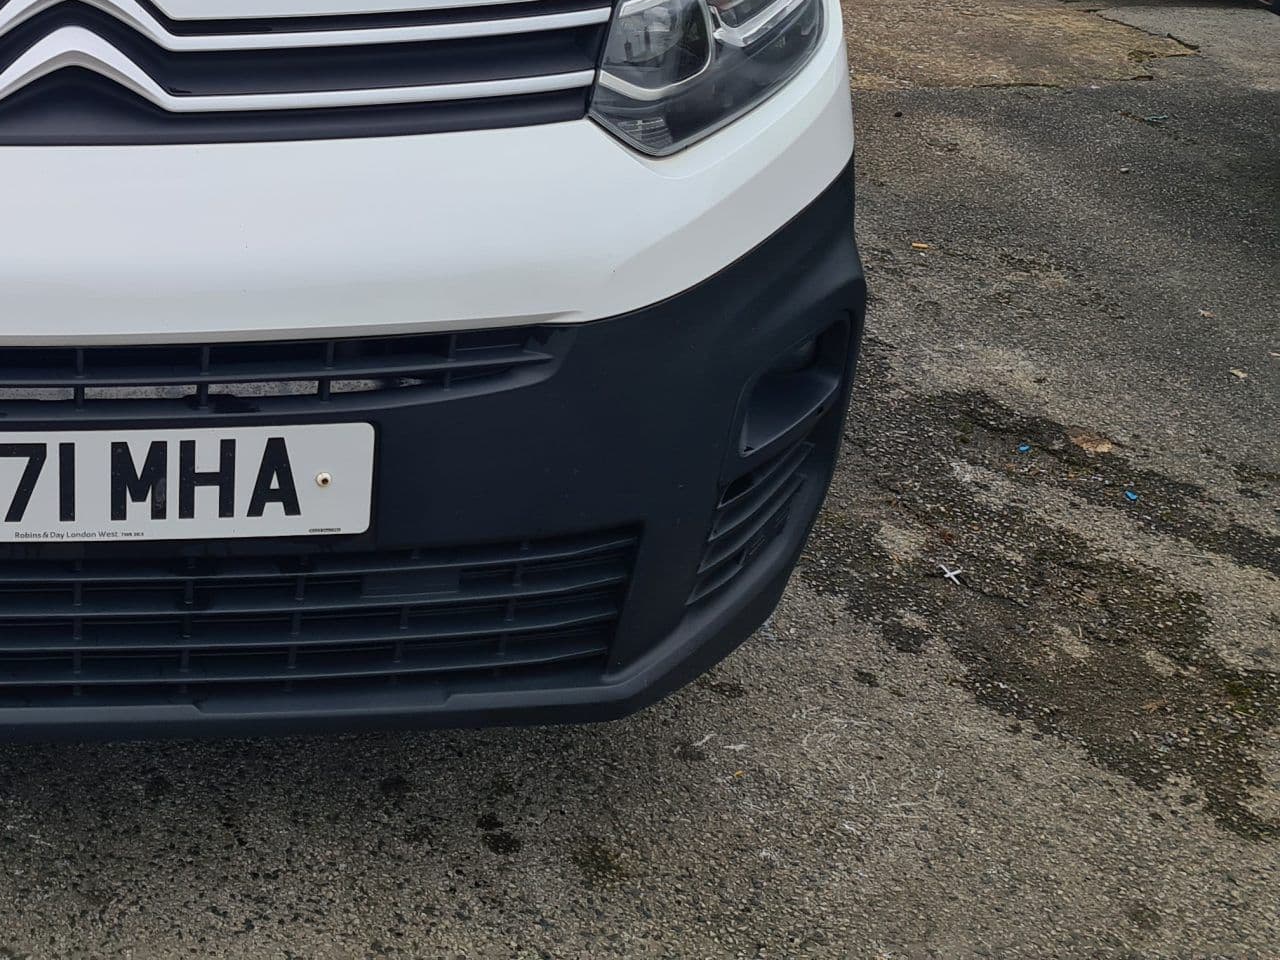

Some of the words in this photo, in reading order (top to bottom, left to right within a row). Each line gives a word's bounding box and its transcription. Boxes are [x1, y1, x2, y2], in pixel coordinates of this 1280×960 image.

[110, 436, 302, 522] MHA
[14, 531, 41, 539] Robins
[50, 531, 65, 540] Day
[66, 530, 97, 538] London
[99, 530, 118, 538] West
